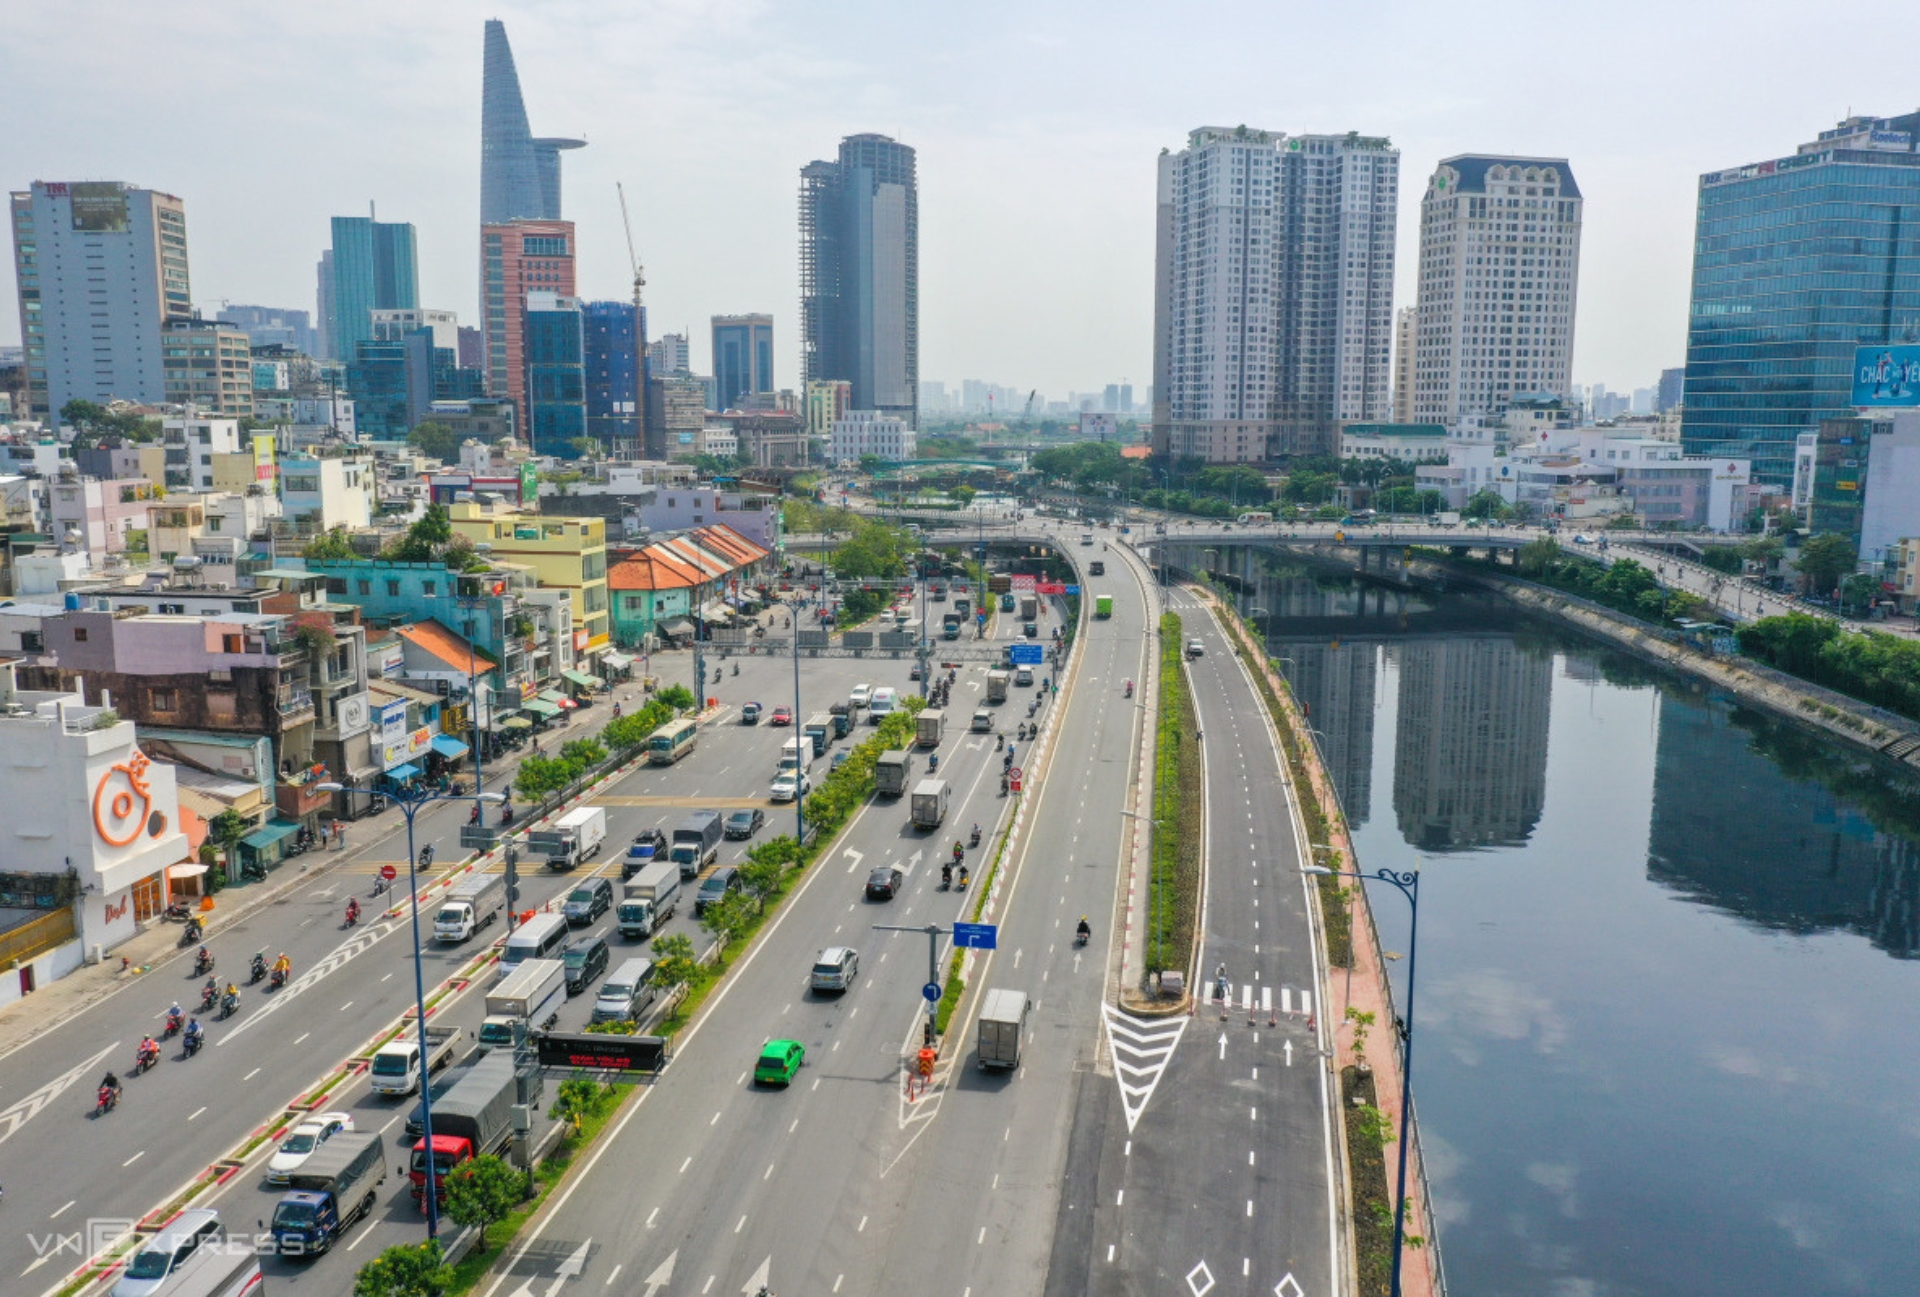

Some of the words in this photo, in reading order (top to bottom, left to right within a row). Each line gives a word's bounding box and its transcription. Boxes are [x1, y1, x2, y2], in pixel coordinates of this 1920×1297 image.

[1777, 150, 1831, 170] CREDIT
[45, 182, 68, 194] TNR
[1905, 361, 1920, 383] YÊ
